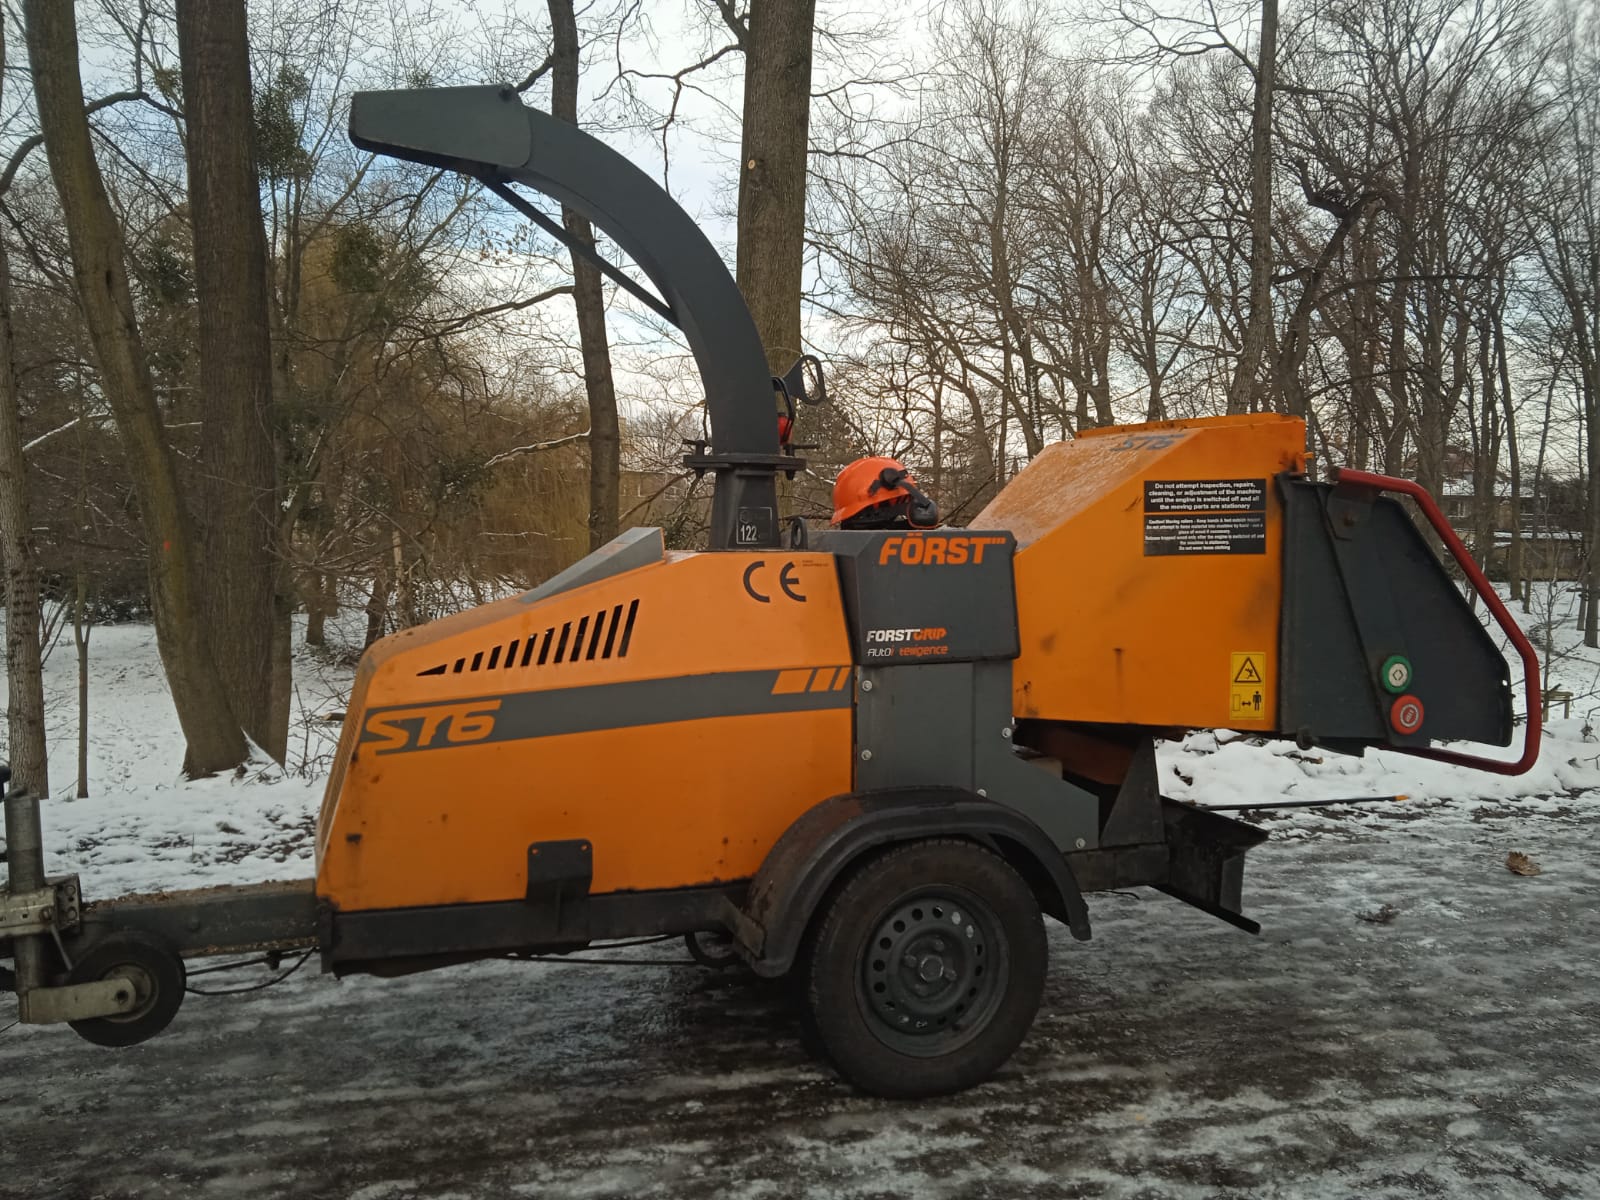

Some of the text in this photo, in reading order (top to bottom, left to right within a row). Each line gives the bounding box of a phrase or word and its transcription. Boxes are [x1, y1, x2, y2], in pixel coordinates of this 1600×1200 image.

[740, 525, 758, 541] 122
[879, 532, 1006, 565] FÖRST
[743, 561, 807, 603] CE
[359, 699, 502, 756] ST6
